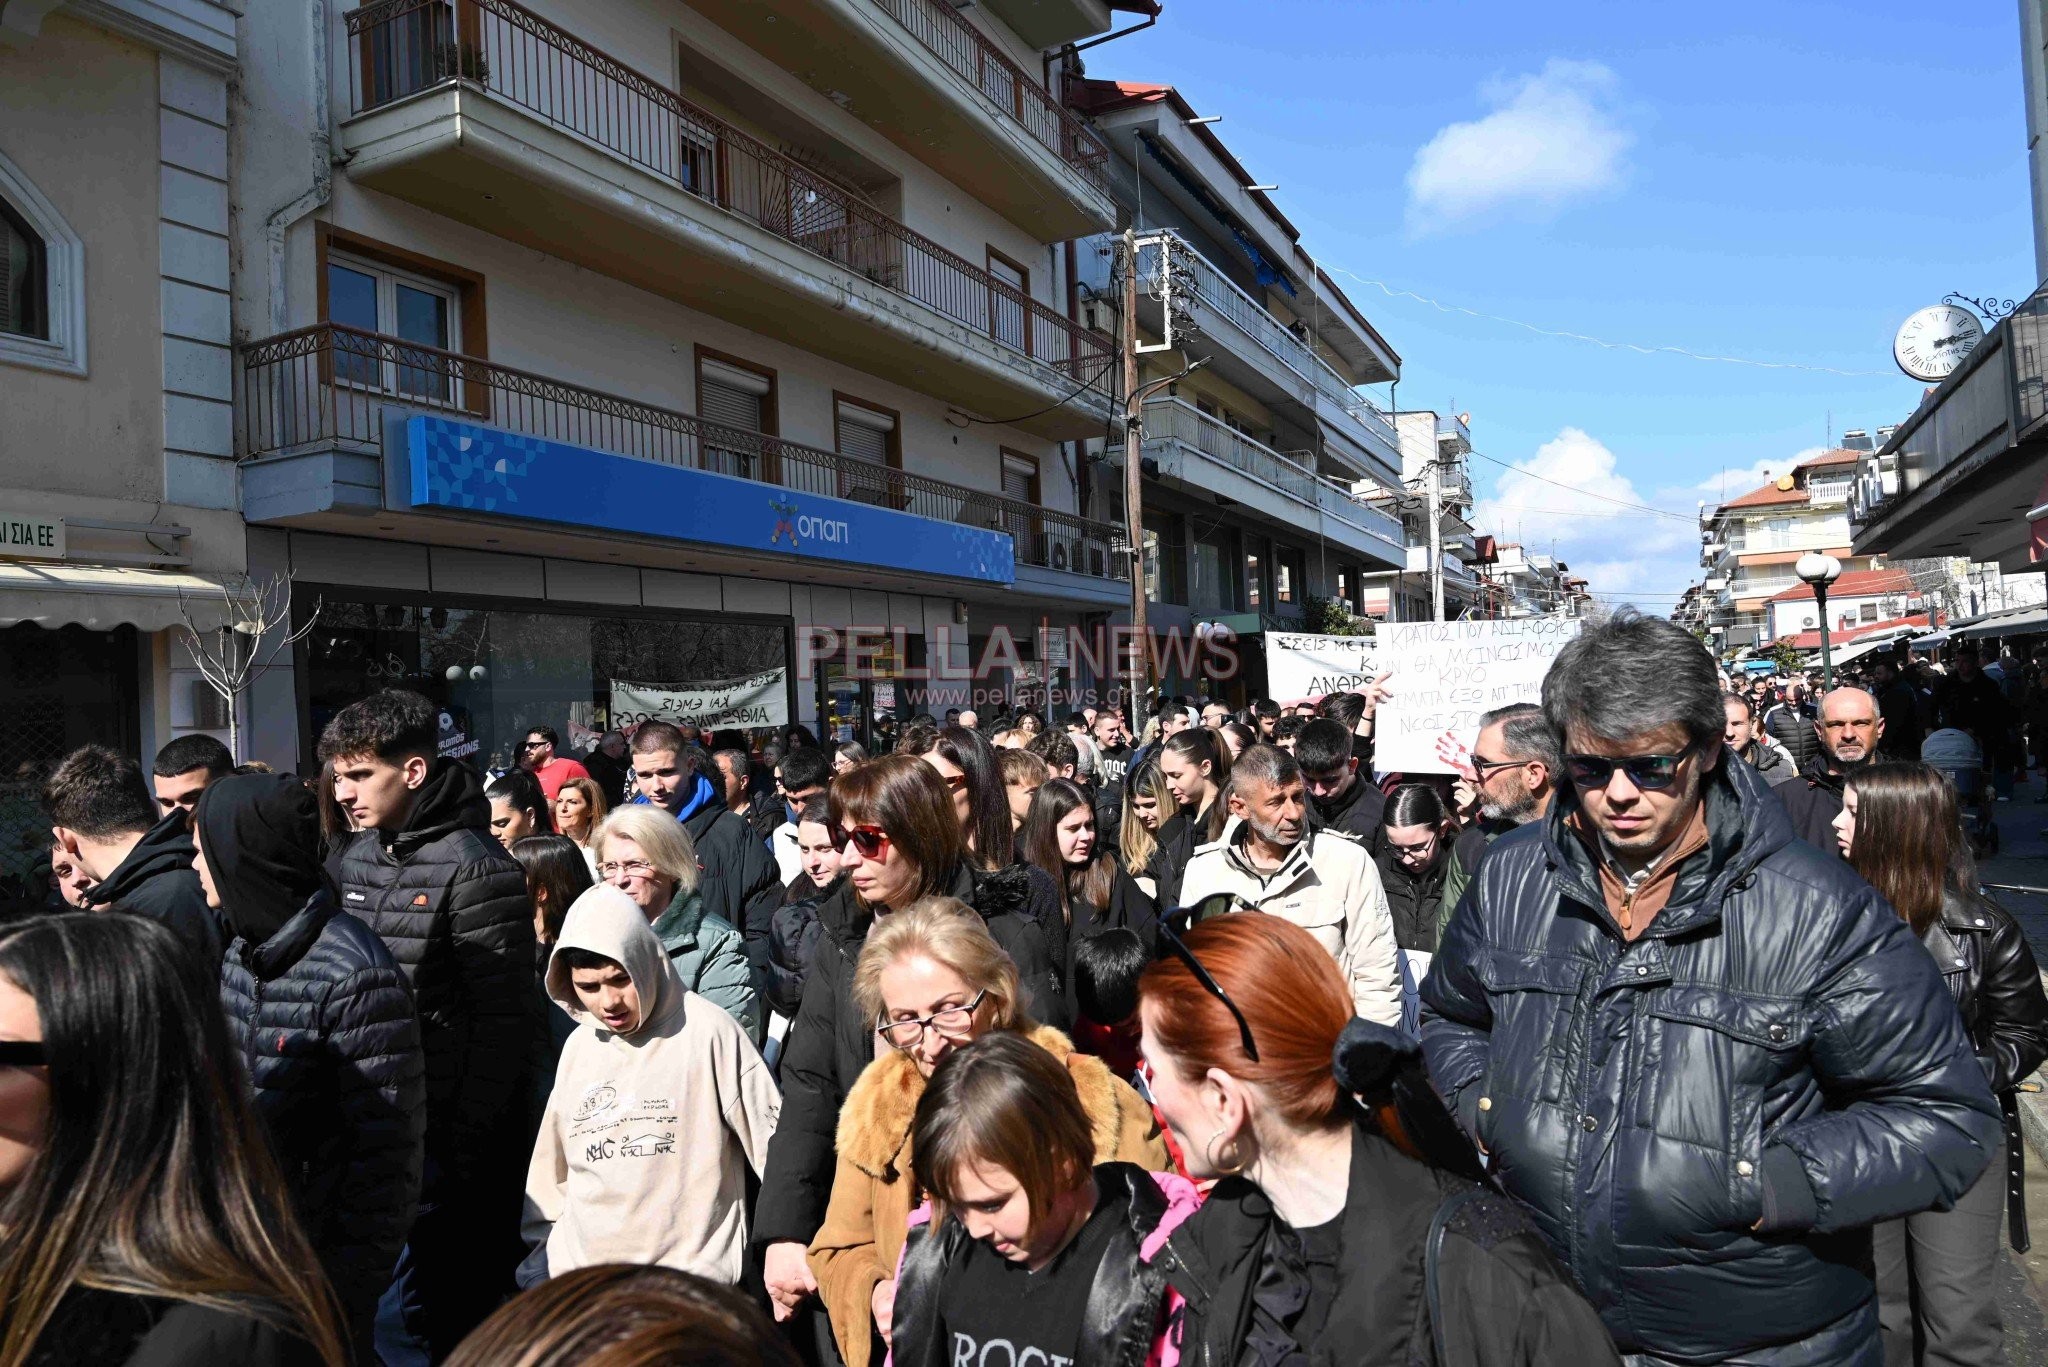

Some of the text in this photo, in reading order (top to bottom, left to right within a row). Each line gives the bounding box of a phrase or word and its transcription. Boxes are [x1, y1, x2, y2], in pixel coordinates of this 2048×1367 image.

[11, 522, 34, 545] ΣΙΑ
[38, 525, 54, 547] ΕΕ
[1391, 624, 1454, 650] ΚΡΑΤΟΣ
[1458, 621, 1484, 639] ΠΟΥ
[1360, 655, 1378, 672] Κ
[1415, 654, 1438, 673] ΘΑ
[1446, 642, 1524, 668] ΜΕΙΝΕΙΣ
[1439, 666, 1487, 686] ΚΡΥΟ
[1450, 687, 1483, 704] ΕΞΩ
[953, 1331, 1074, 1367] ROC
